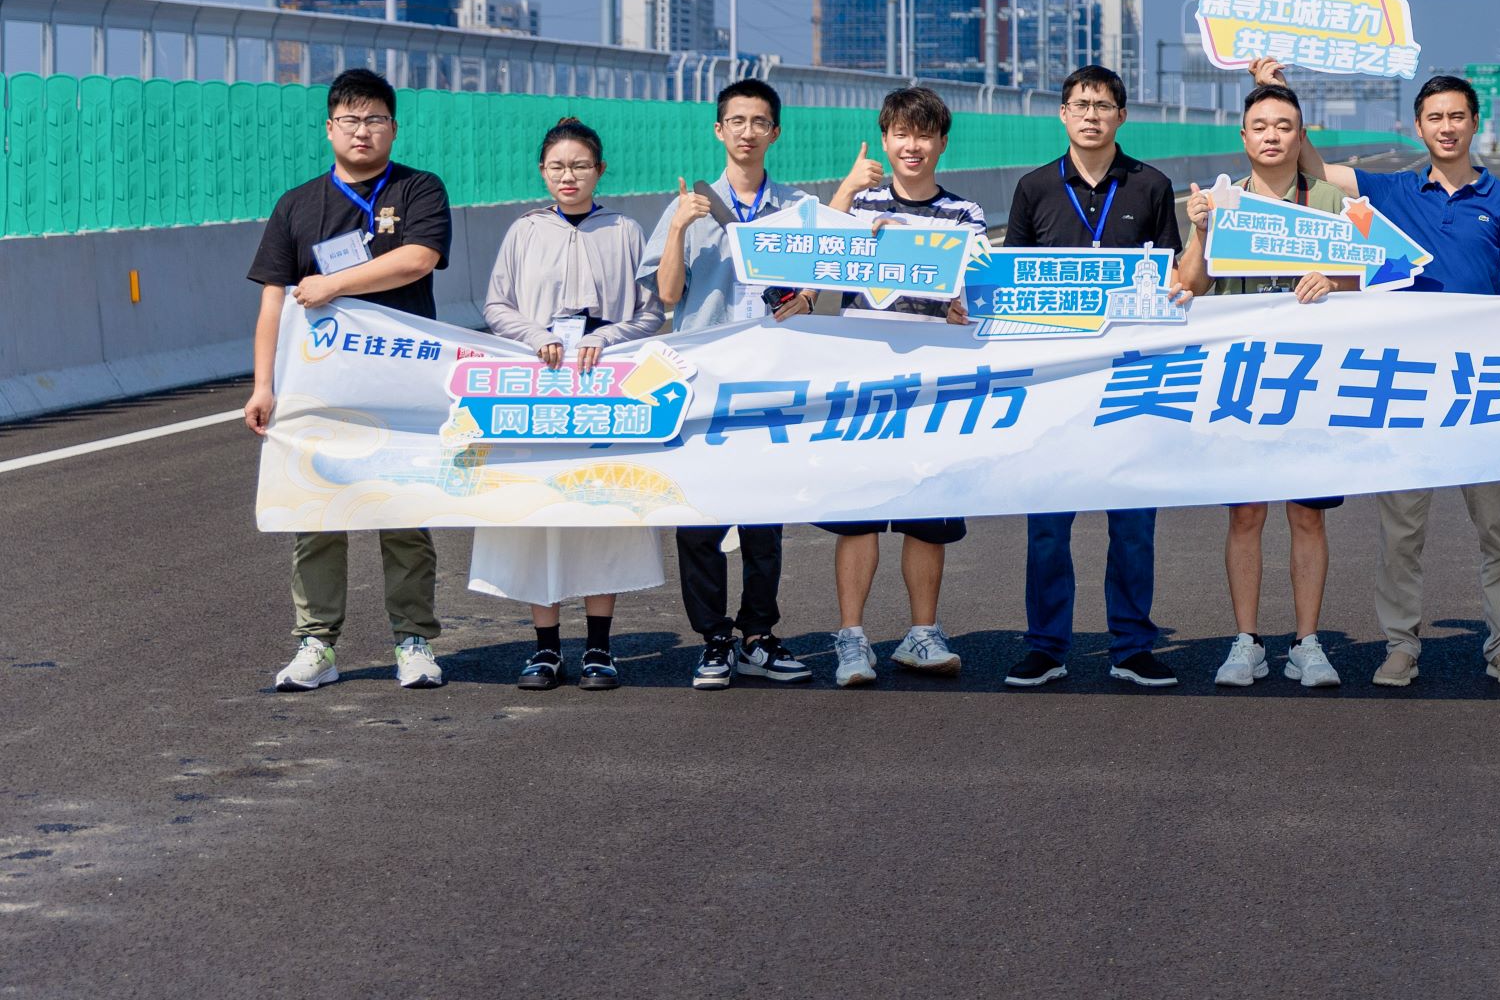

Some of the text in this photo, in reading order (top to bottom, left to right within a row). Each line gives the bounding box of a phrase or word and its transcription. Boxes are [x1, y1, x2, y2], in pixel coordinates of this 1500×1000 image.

[1235, 30, 1418, 77] 共享生活之美
[754, 232, 878, 257] 芜湖焕新
[813, 261, 938, 284] 美好同行
[1016, 260, 1122, 282] 聚焦高质量
[994, 289, 1101, 313] 共筑芜湖梦
[342, 333, 442, 361] E往芜前
[467, 366, 615, 396] E启美好
[491, 404, 652, 435] 网聚芜湖
[589, 365, 1034, 448] 民城市
